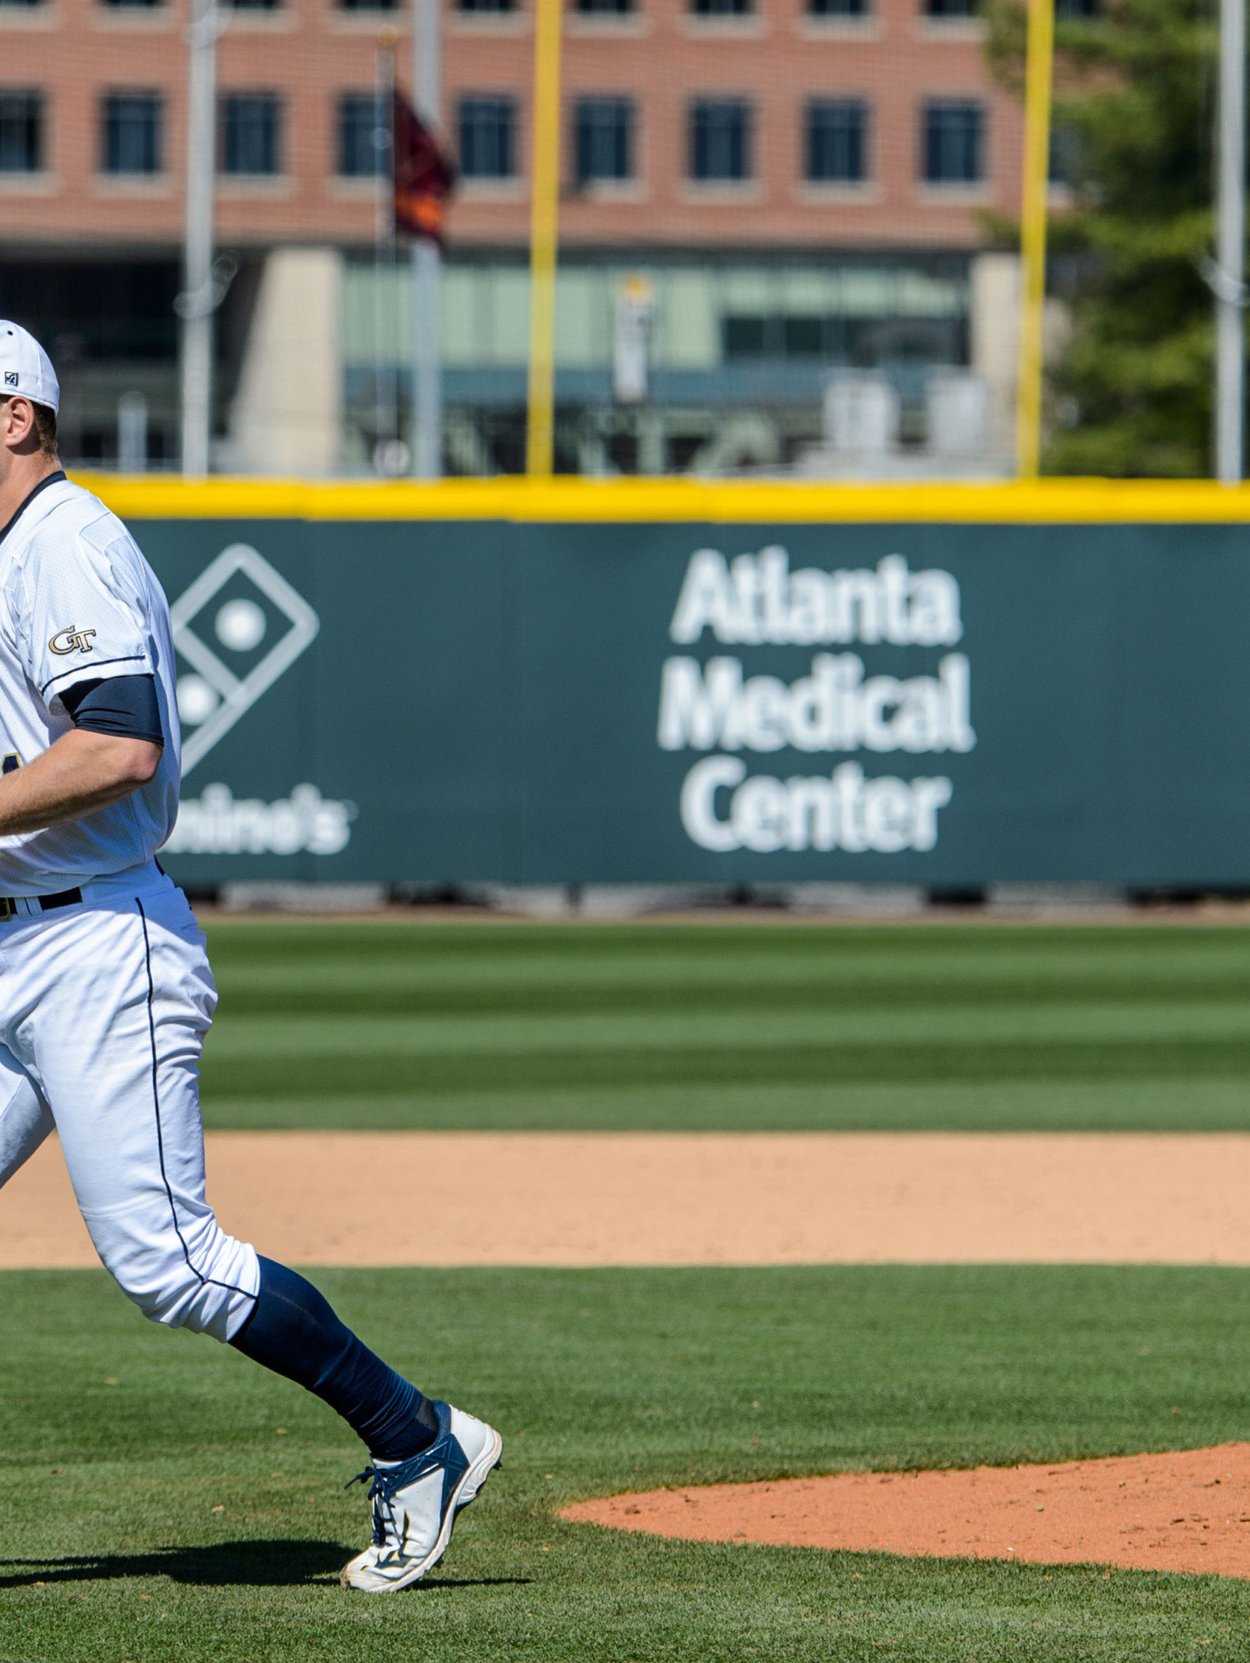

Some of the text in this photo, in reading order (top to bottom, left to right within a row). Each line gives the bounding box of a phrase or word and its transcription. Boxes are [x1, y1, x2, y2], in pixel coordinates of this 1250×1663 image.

[49, 625, 97, 655] GT
[670, 547, 962, 646] Atlanta
[659, 654, 974, 752] Medical
[158, 783, 351, 855] mino's
[681, 756, 952, 853] Center
